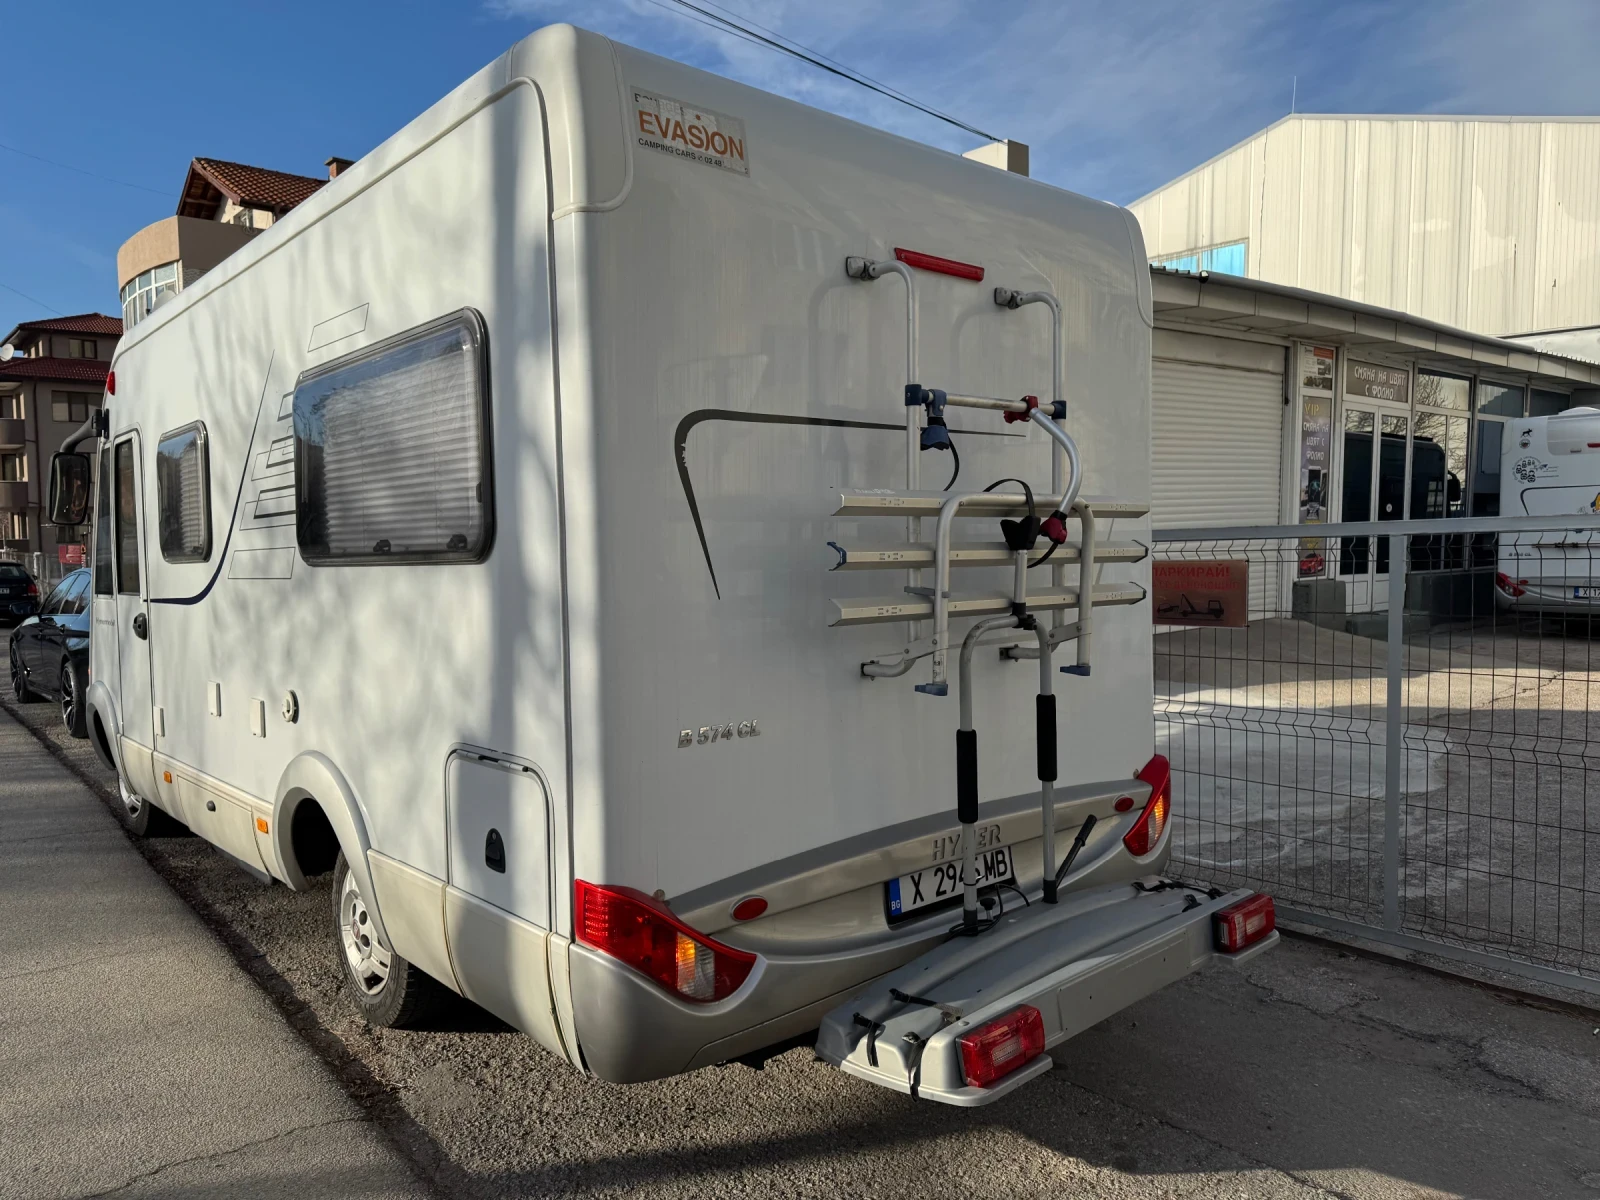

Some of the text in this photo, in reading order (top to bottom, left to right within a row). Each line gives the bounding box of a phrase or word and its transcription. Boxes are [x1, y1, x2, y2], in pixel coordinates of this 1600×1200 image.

[638, 110, 745, 161] EVASION
[638, 138, 674, 154] CAMPING
[675, 149, 697, 160] CARS
[704, 156, 713, 165] 02
[713, 158, 722, 167] 48
[1354, 365, 1405, 387] СМЯНА НА ЦВЯТ
[1365, 384, 1394, 400] С ФОЛИО
[1304, 403, 1320, 416] VIP
[1582, 588, 1588, 596] X
[677, 719, 761, 748] B 574 CL
[932, 824, 1001, 861] HYER
[891, 900, 901, 910] BG
[910, 872, 925, 905] X
[983, 850, 1008, 882] MB
